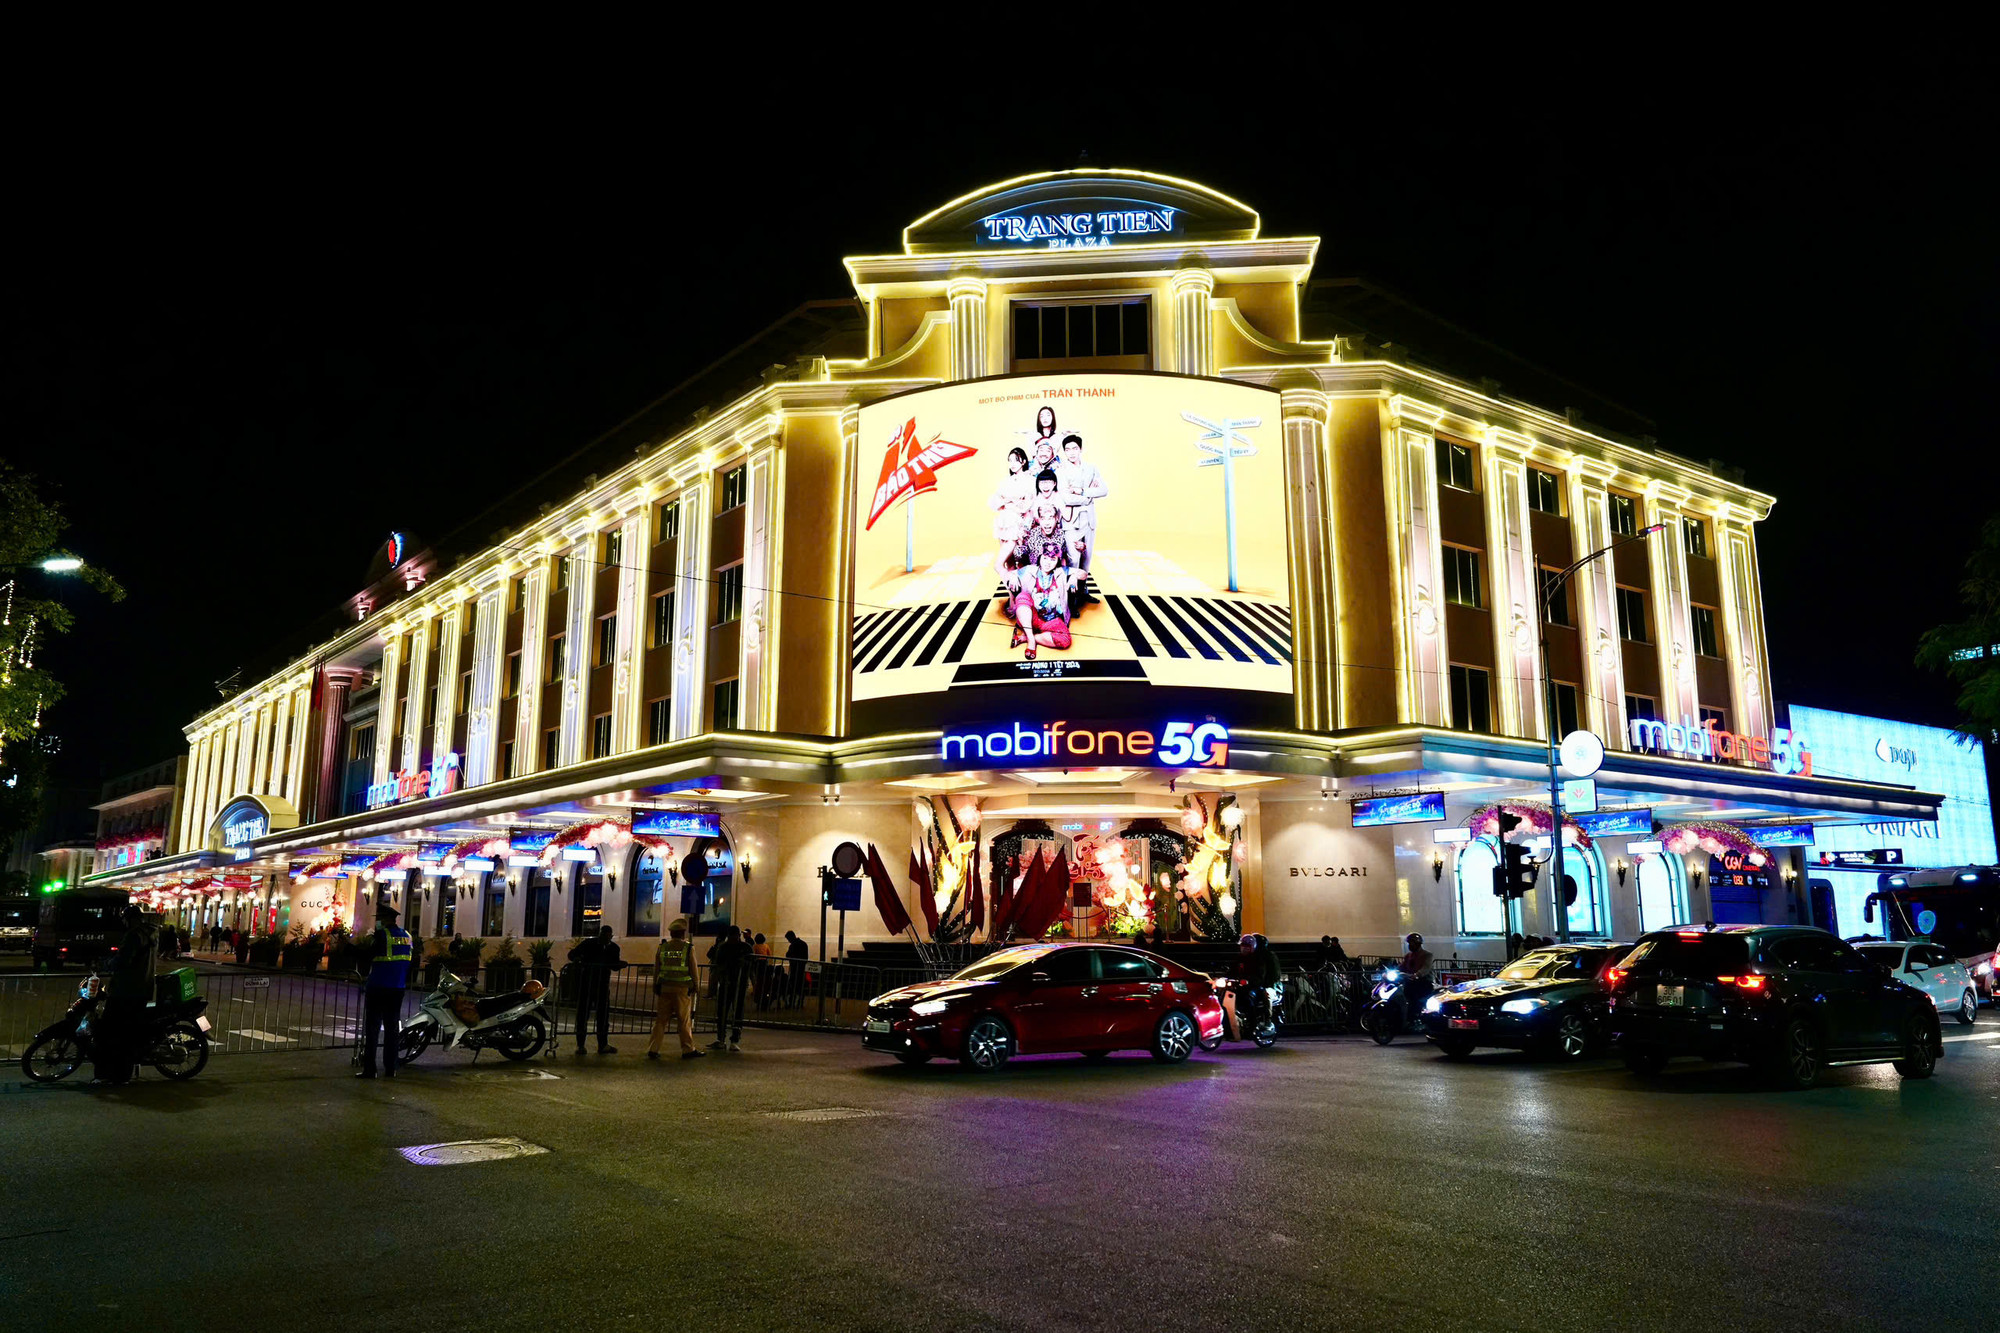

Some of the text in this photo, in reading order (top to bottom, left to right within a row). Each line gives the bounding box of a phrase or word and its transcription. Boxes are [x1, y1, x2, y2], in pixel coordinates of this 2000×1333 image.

[985, 210, 1174, 241] TRANG TIEN
[1048, 236, 1111, 249] PLAZA
[942, 720, 1229, 767] mobifone 5G
[1630, 715, 1812, 777] mobifone 5G
[366, 752, 458, 807] mobifone 5G
[1724, 855, 1743, 871] CGV
[1886, 850, 1898, 863] P
[1289, 866, 1368, 878] BVLGARI
[1663, 986, 1678, 996] 30F
